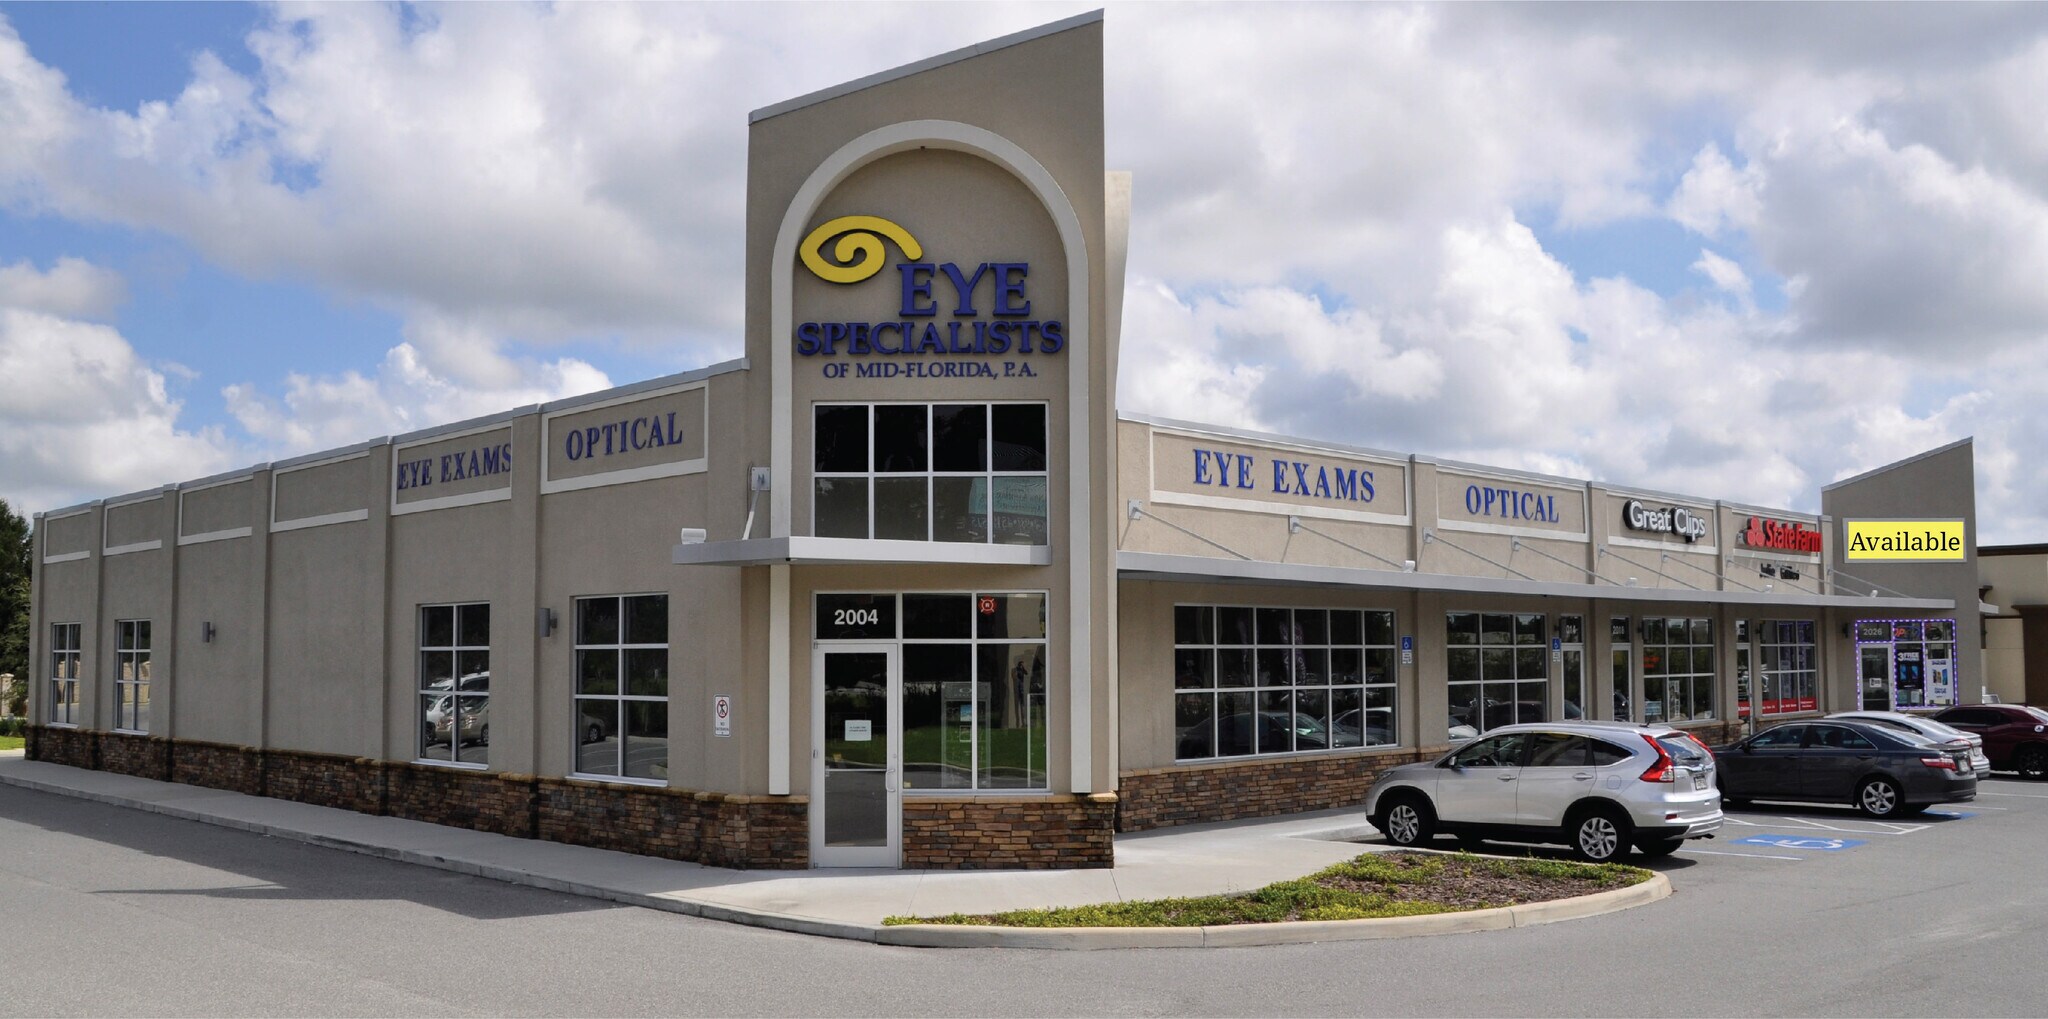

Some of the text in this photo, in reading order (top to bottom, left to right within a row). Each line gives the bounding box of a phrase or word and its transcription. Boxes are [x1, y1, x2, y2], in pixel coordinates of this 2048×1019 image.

[897, 262, 1031, 317] EYE
[797, 321, 1064, 356] SPECIALISTS
[823, 363, 849, 379] OF
[856, 362, 998, 379] MID-FLORIDA,
[565, 412, 683, 461] OPTICAL
[397, 443, 512, 490] EYE EXAMS
[1193, 448, 1375, 503] EYE EXAMS
[1465, 485, 1559, 524] OPTICAL
[1624, 499, 1705, 542] Great Clips
[834, 609, 879, 625] 2004
[1863, 628, 1882, 636] 2026
